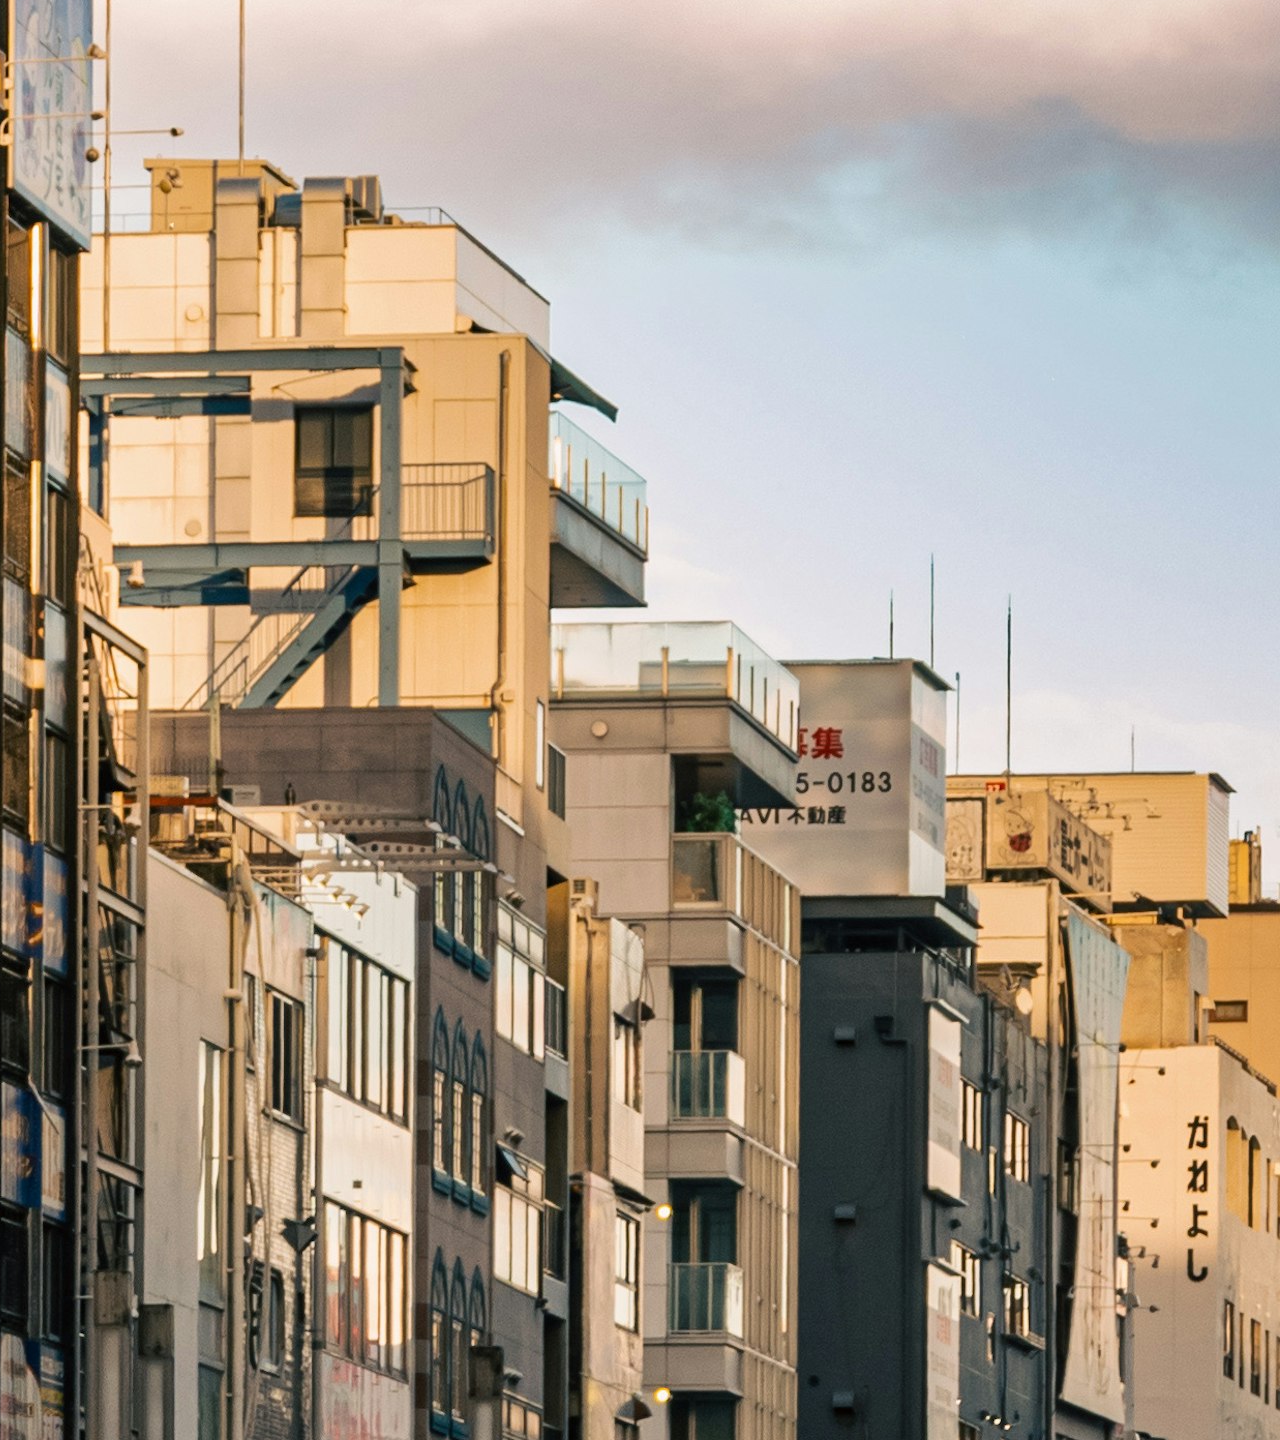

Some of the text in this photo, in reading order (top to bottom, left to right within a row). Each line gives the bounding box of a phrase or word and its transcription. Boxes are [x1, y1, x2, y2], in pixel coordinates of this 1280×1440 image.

[785, 805, 847, 827] 不動産
[1187, 1113, 1209, 1283] かねよし
